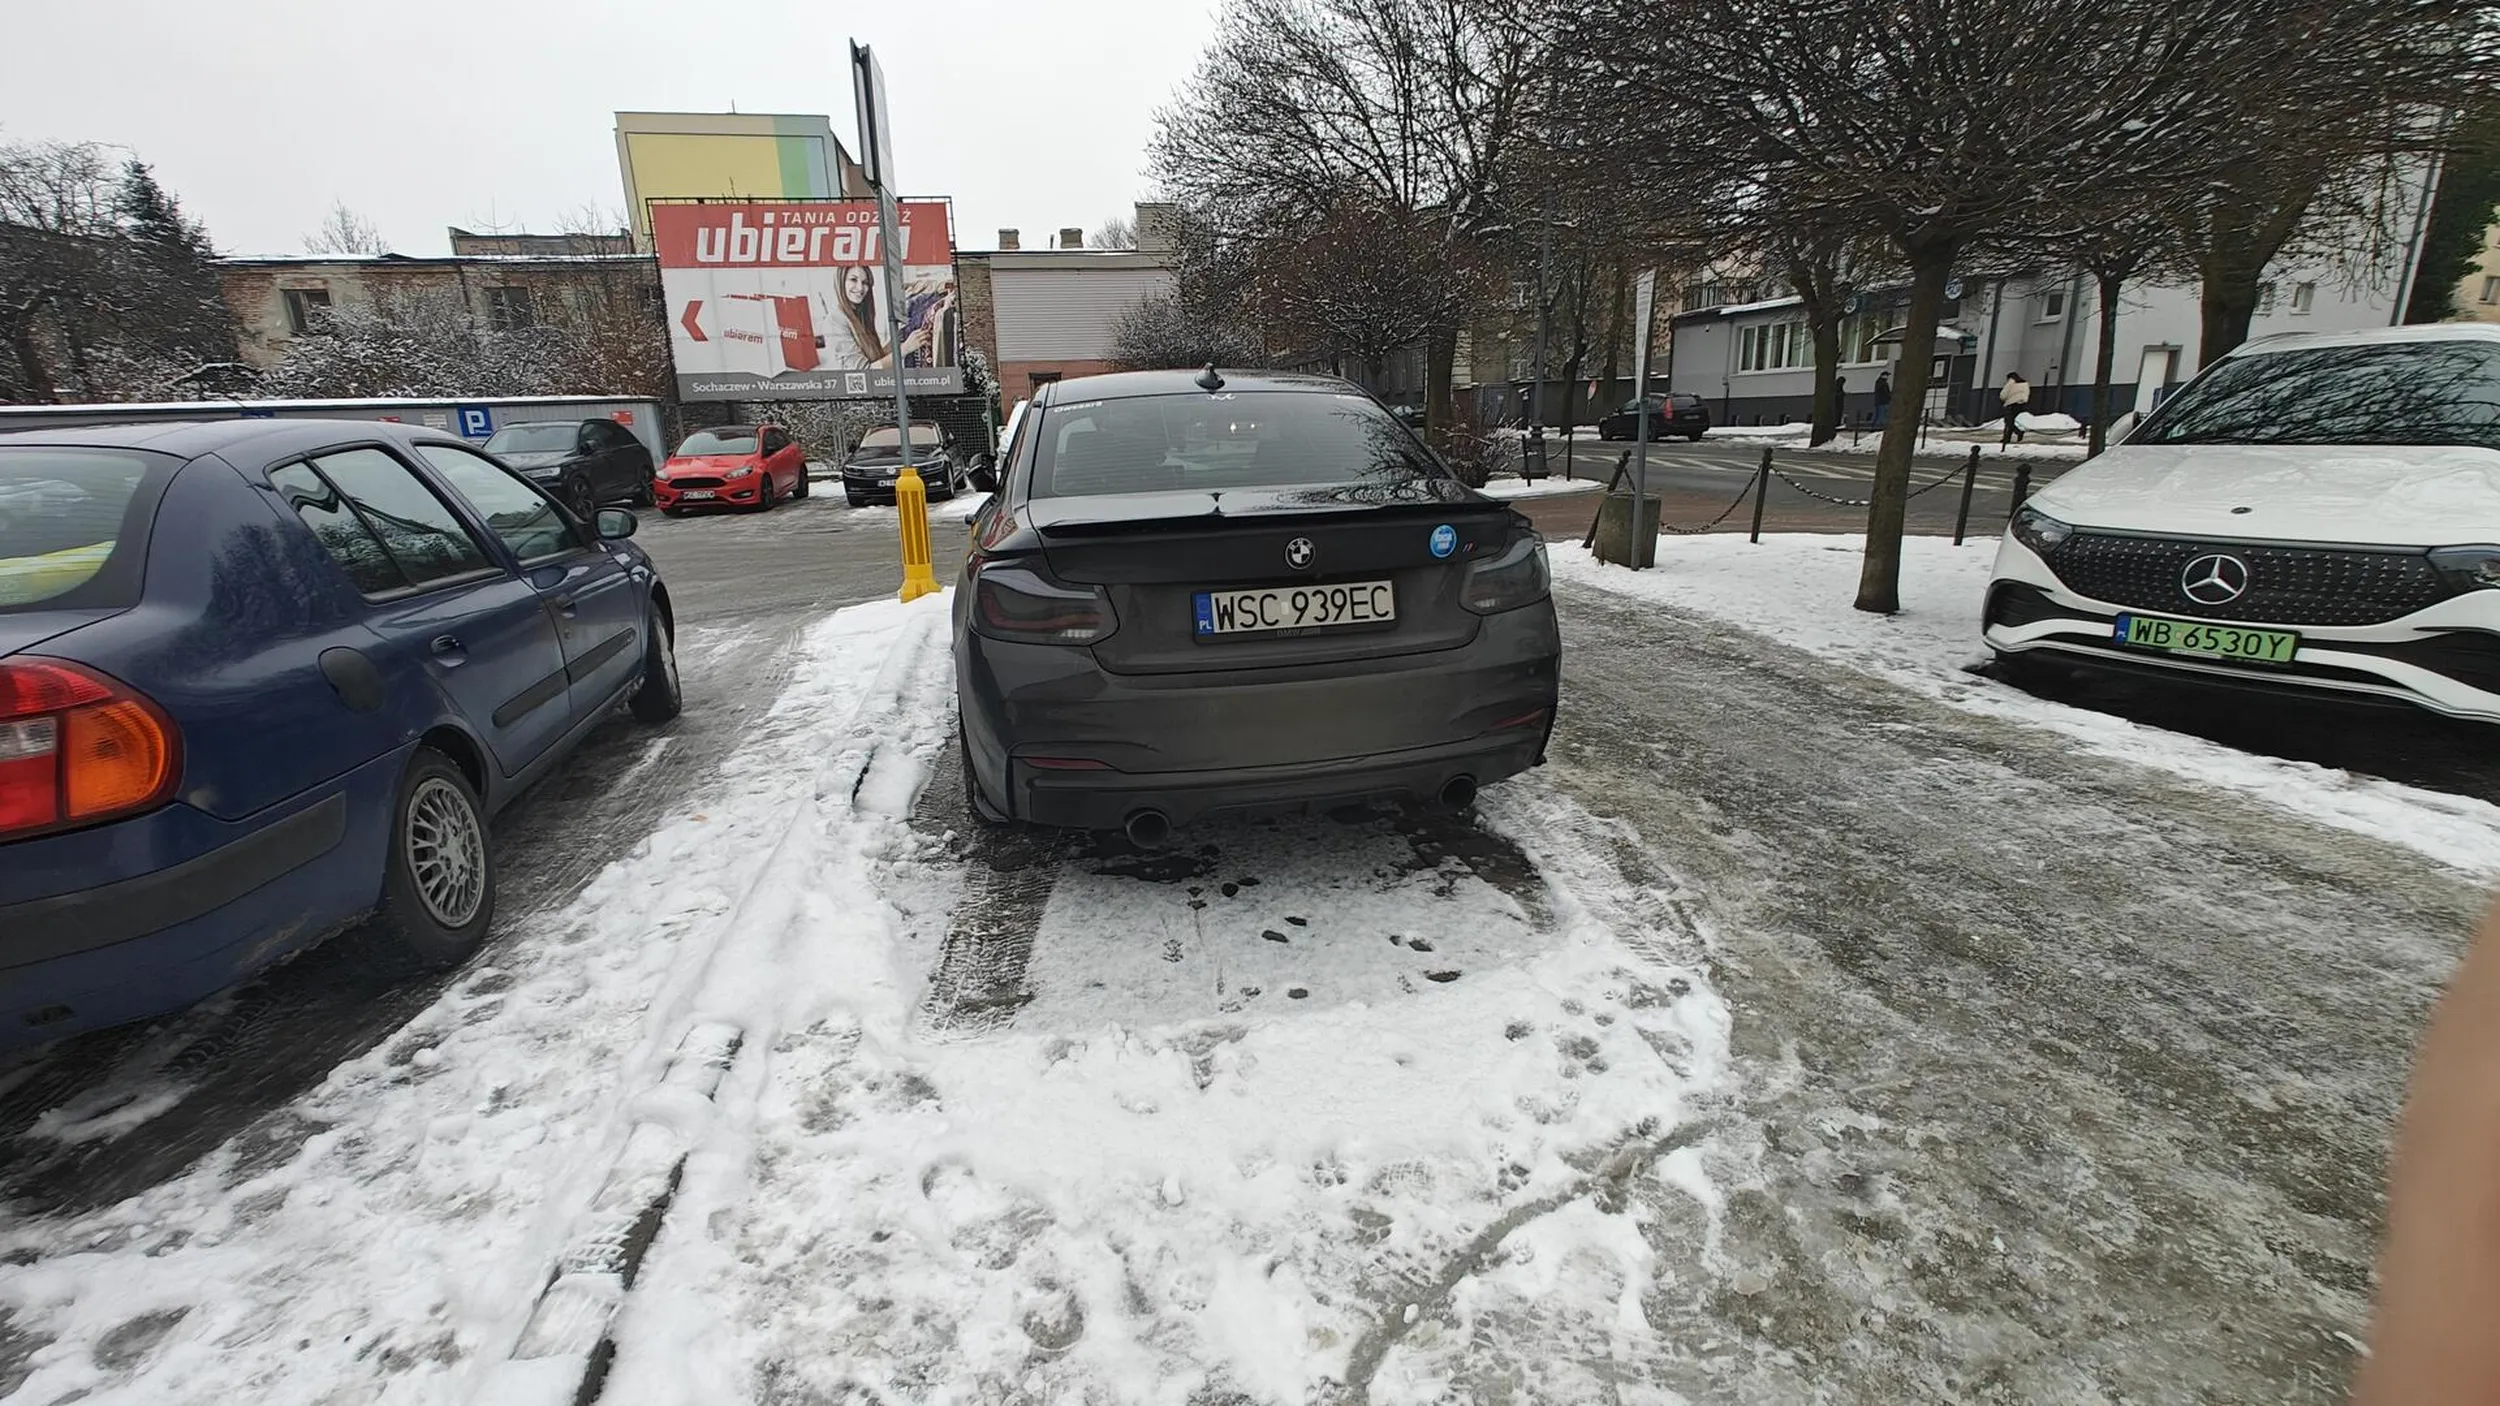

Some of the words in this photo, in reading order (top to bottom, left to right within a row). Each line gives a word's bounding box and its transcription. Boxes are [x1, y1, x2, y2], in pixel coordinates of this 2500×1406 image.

[782, 212, 836, 224] TANIA
[846, 208, 912, 224] ODZŻ
[692, 382, 750, 393] Sochaczew
[757, 380, 822, 391] Warszawska
[824, 379, 837, 390] 37
[465, 410, 486, 435] P
[1199, 620, 1212, 630] PL
[1215, 593, 1280, 631] WSC
[1291, 585, 1390, 624] 939EC
[2134, 619, 2172, 645] WB
[2183, 626, 2287, 659] 6530Y
